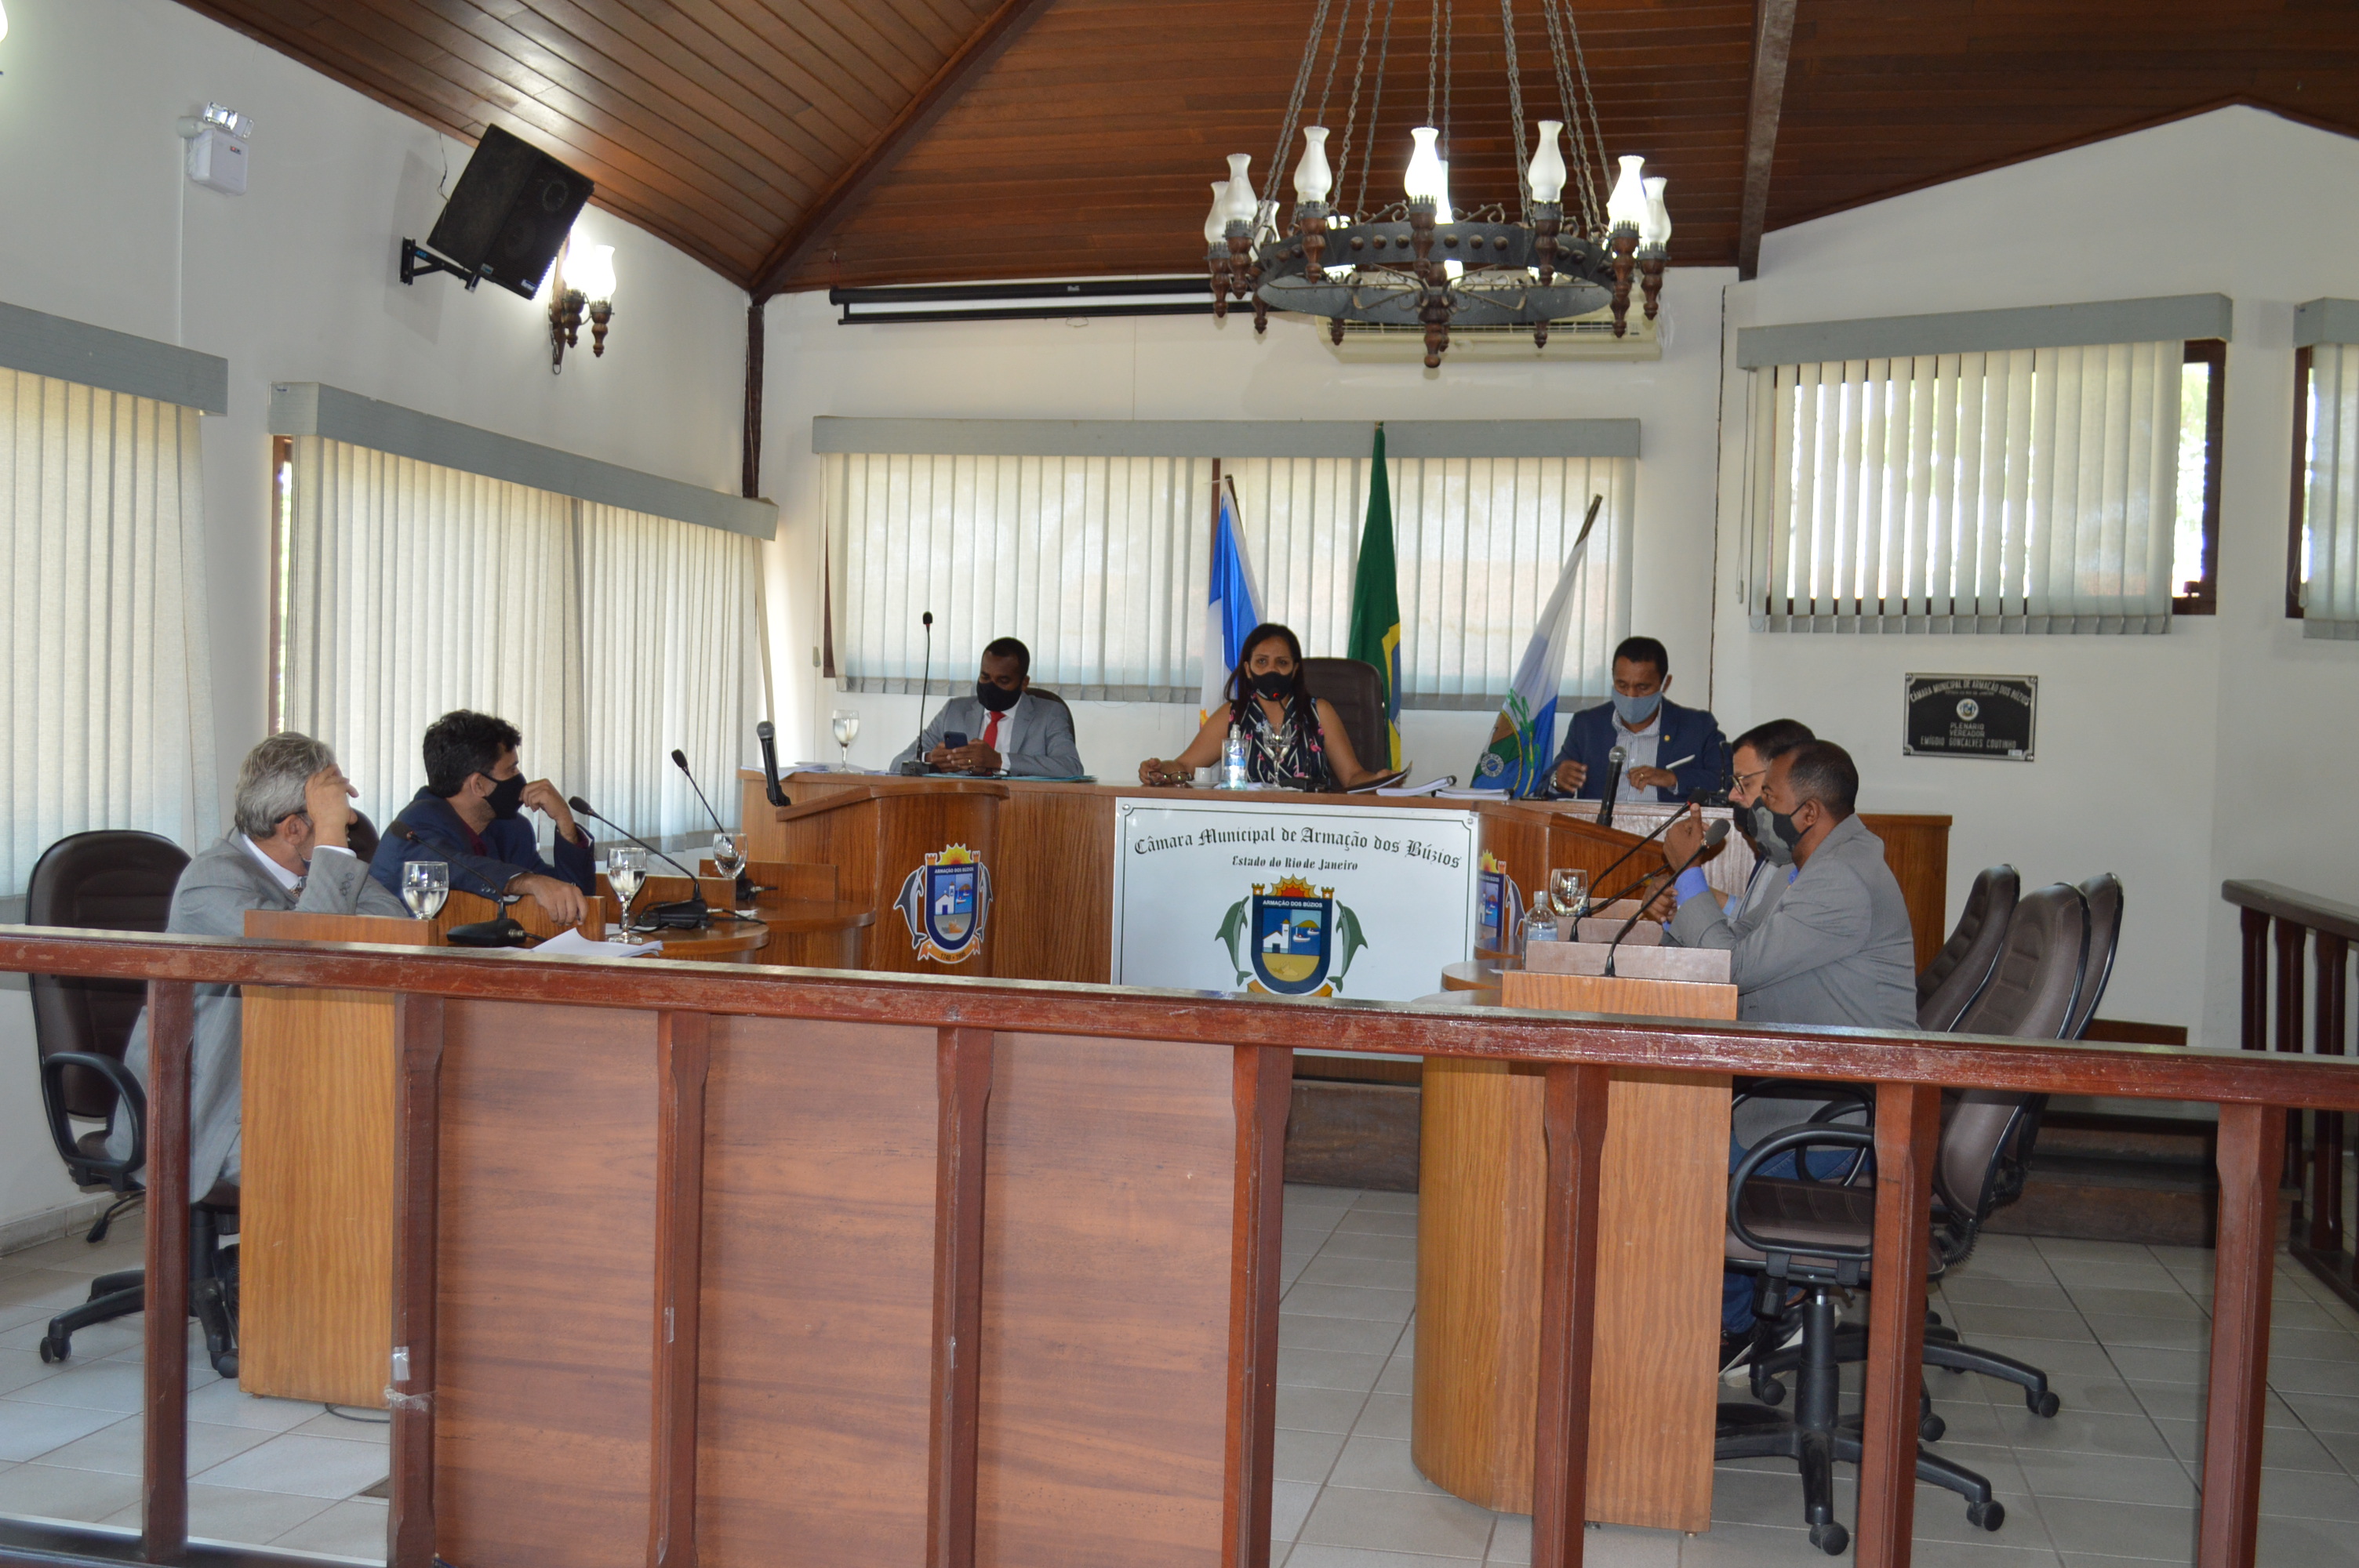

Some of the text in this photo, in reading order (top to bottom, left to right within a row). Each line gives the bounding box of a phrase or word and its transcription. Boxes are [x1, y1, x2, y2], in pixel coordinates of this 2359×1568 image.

[1963, 679, 1971, 689] DE
[1986, 739, 2017, 749] COUTINHO
[1134, 826, 1463, 869] Câmara Municipal de Armação dos Búzios
[1232, 855, 1358, 871] Estado do Rio de Janeiro
